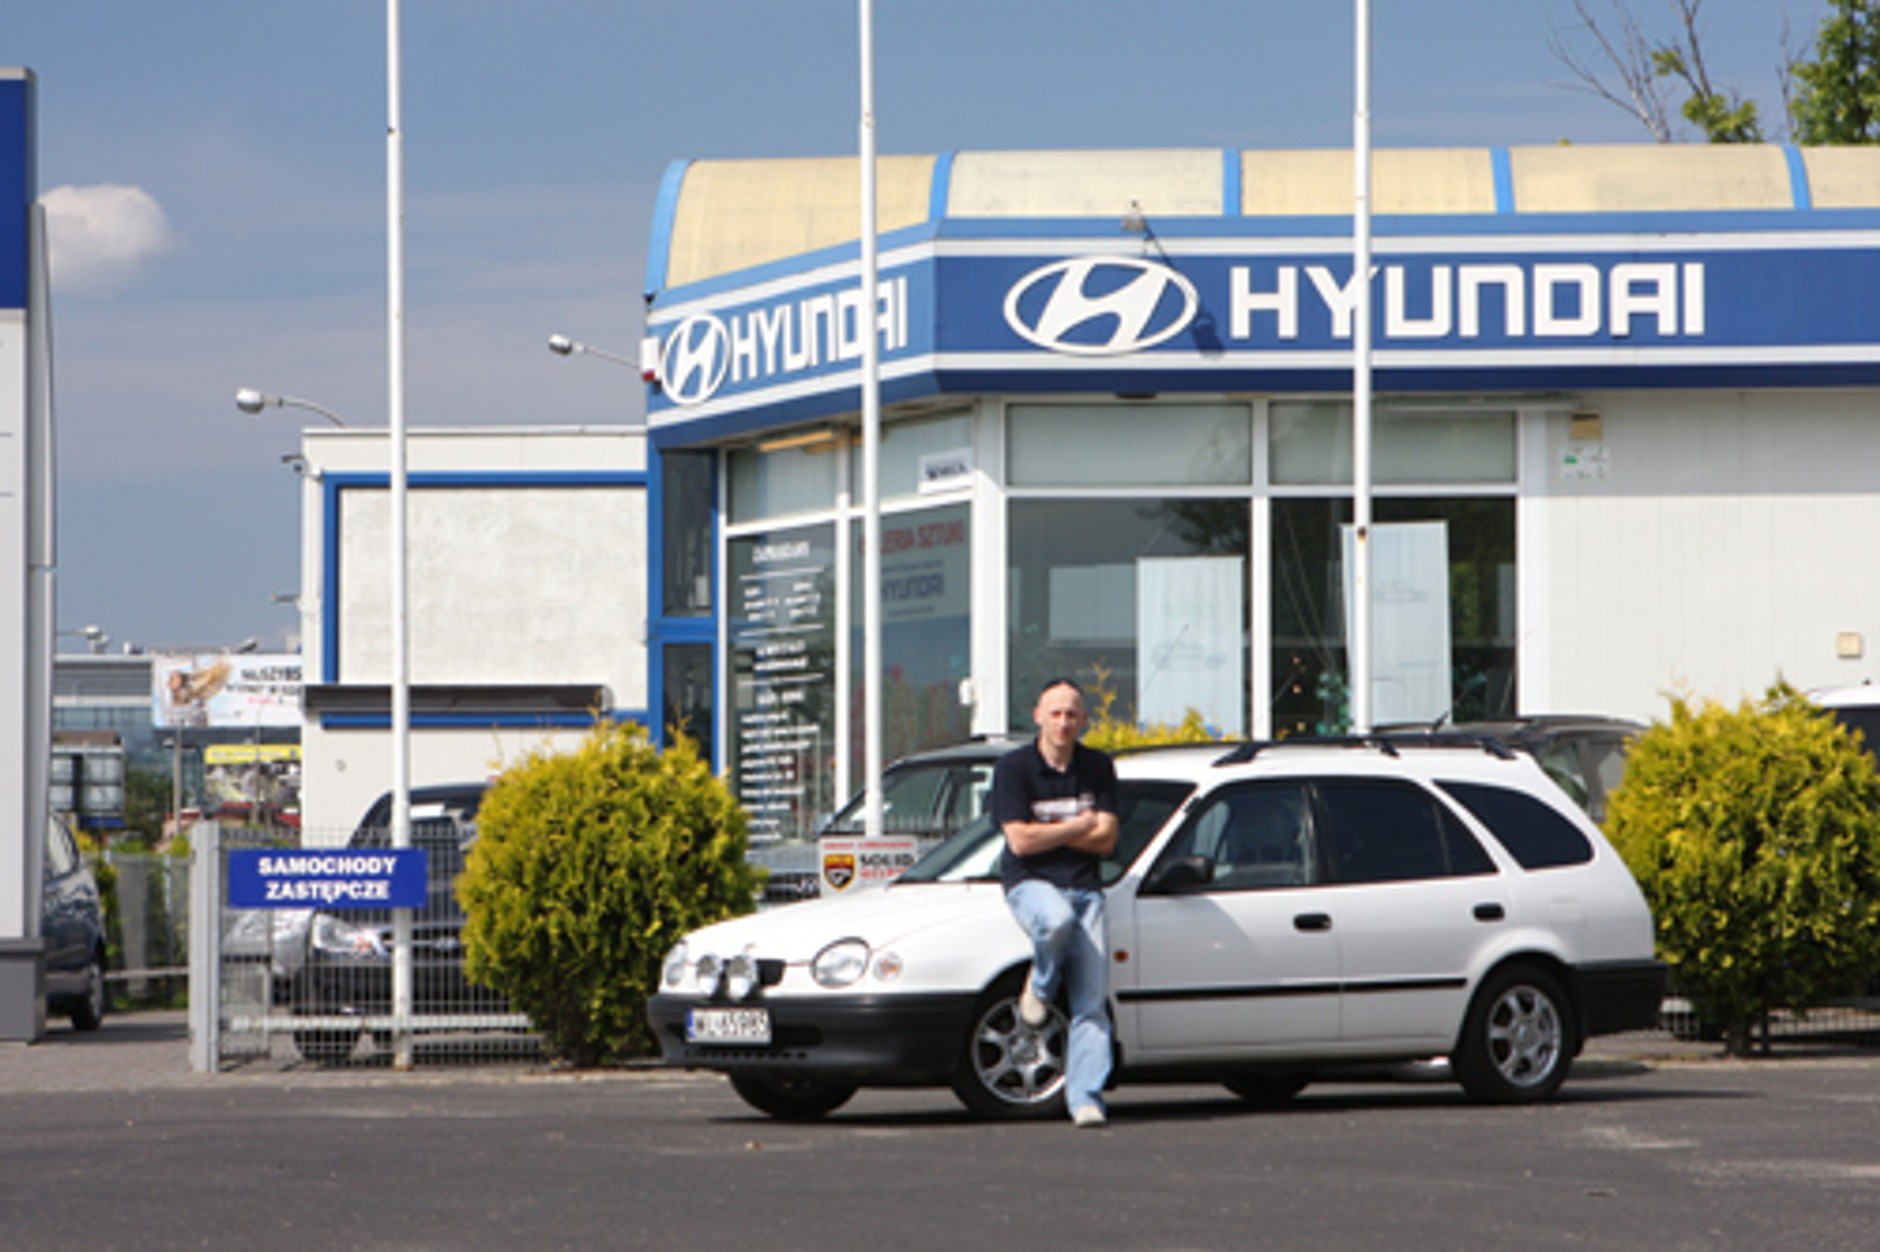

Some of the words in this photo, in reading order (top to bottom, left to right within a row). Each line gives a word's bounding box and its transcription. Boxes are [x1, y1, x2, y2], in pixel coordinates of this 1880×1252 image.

[1230, 263, 1704, 339] HYUNDAI
[731, 276, 908, 382] HYUNDAI
[257, 856, 398, 877] SAMOCHODY
[265, 880, 391, 904] ZASTĘPCZE
